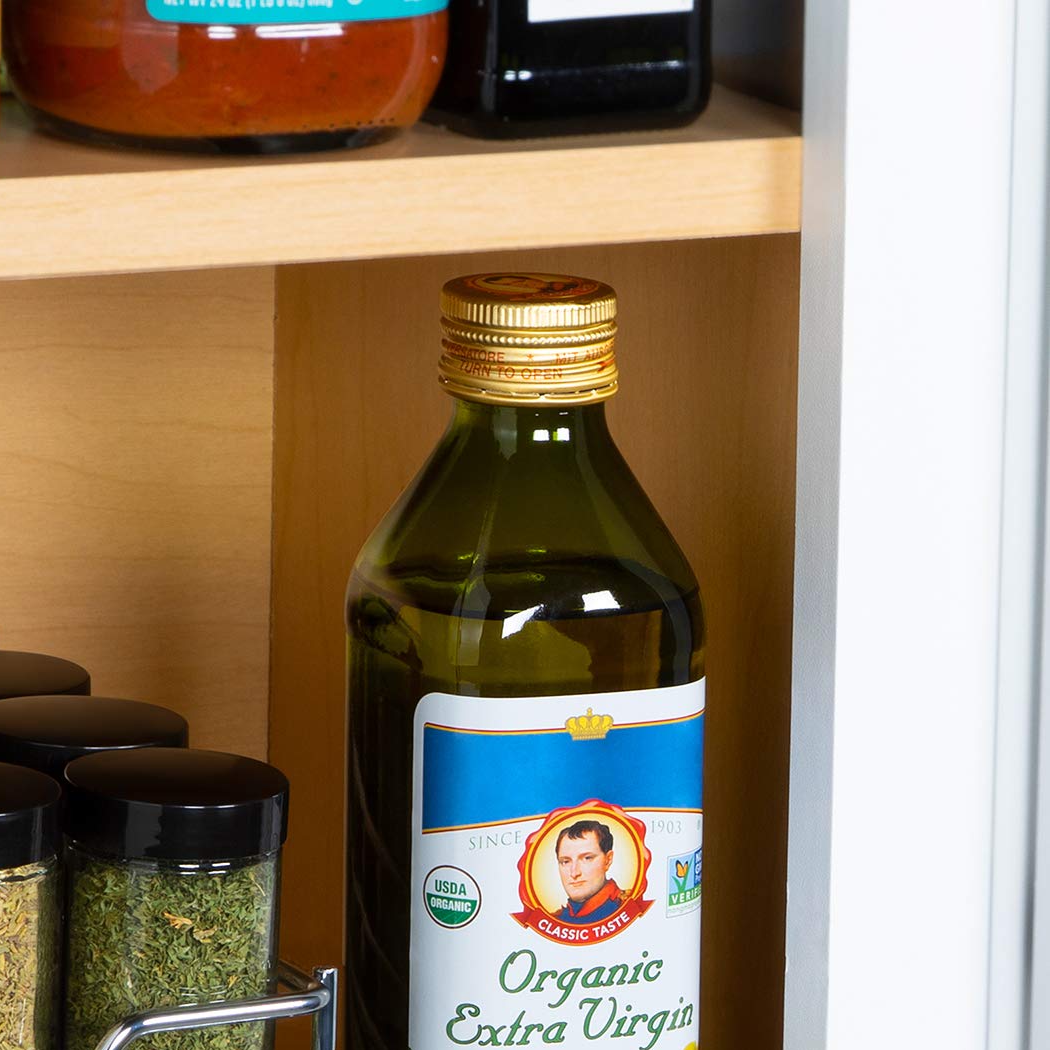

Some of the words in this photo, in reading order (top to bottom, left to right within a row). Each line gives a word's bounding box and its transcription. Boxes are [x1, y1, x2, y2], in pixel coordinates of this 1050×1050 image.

[460, 360, 492, 377] TURN
[497, 364, 516, 379] TO
[520, 367, 563, 380] OPEN
[468, 830, 522, 850] SINCE
[651, 819, 683, 834] 1903
[434, 879, 468, 896] USDA
[429, 896, 472, 913] ORGANIC
[538, 918, 589, 940] CLASSIC
[592, 911, 630, 937] TASTE
[499, 949, 664, 1009] Organic
[446, 1003, 568, 1046] Extra
